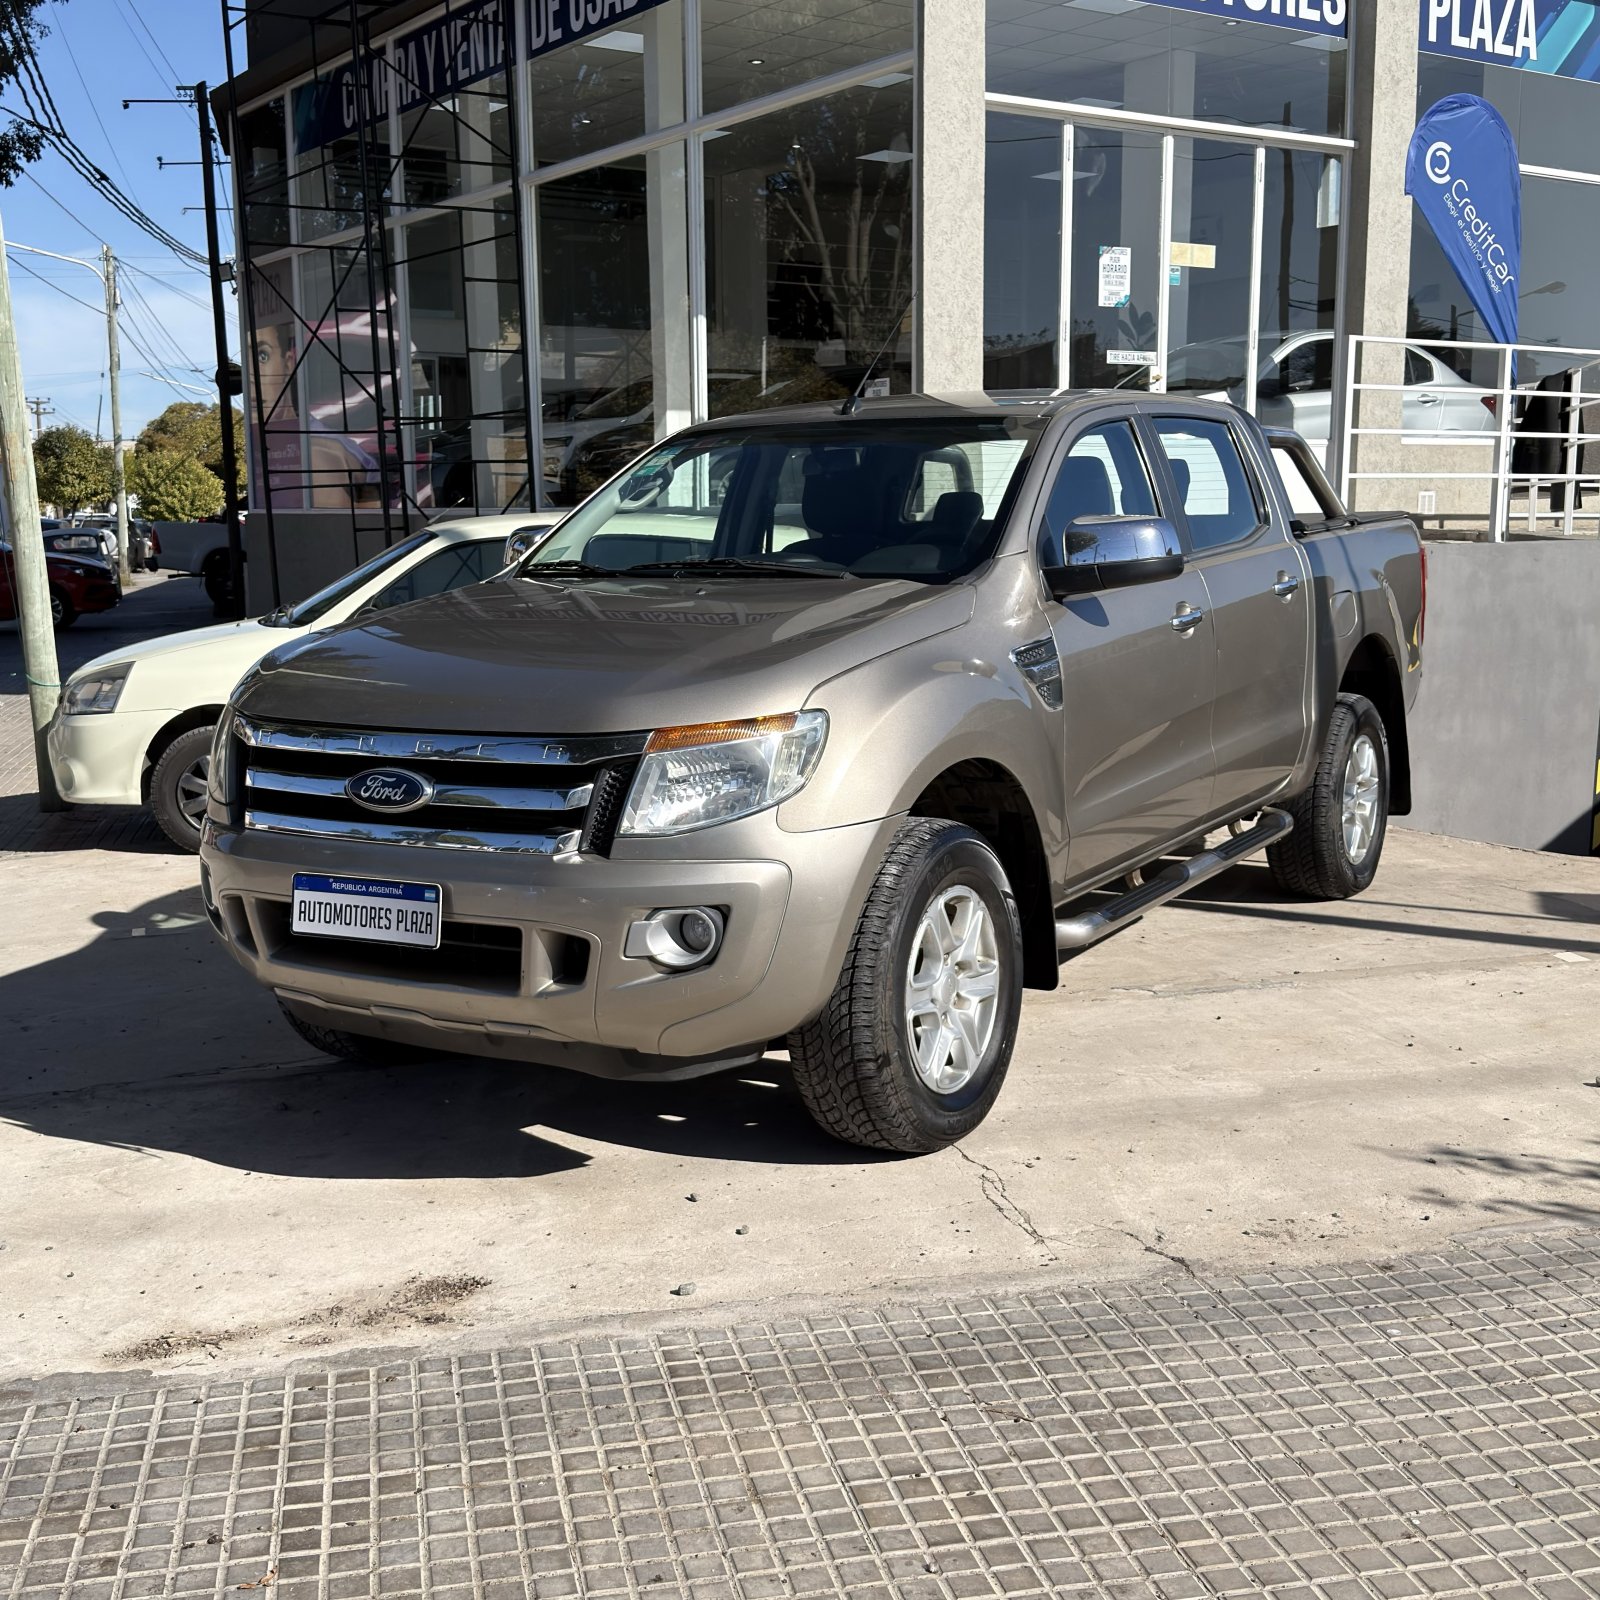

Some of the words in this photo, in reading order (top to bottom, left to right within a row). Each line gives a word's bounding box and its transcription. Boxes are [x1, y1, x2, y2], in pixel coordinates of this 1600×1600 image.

[1428, 0, 1537, 60] PLAZA
[423, 30, 437, 94] Y
[1443, 193, 1459, 218] Elegir
[1457, 218, 1465, 229] el
[1463, 229, 1483, 261] destino
[1485, 268, 1501, 294] llegar
[1452, 179, 1514, 285] CreditCar
[361, 774, 407, 802] Ford
[298, 900, 392, 931] AUTOMOTORES
[396, 909, 433, 935] PLAZA
[332, 882, 366, 892] REPUBLICA
[368, 885, 403, 895] ARGENTINA
